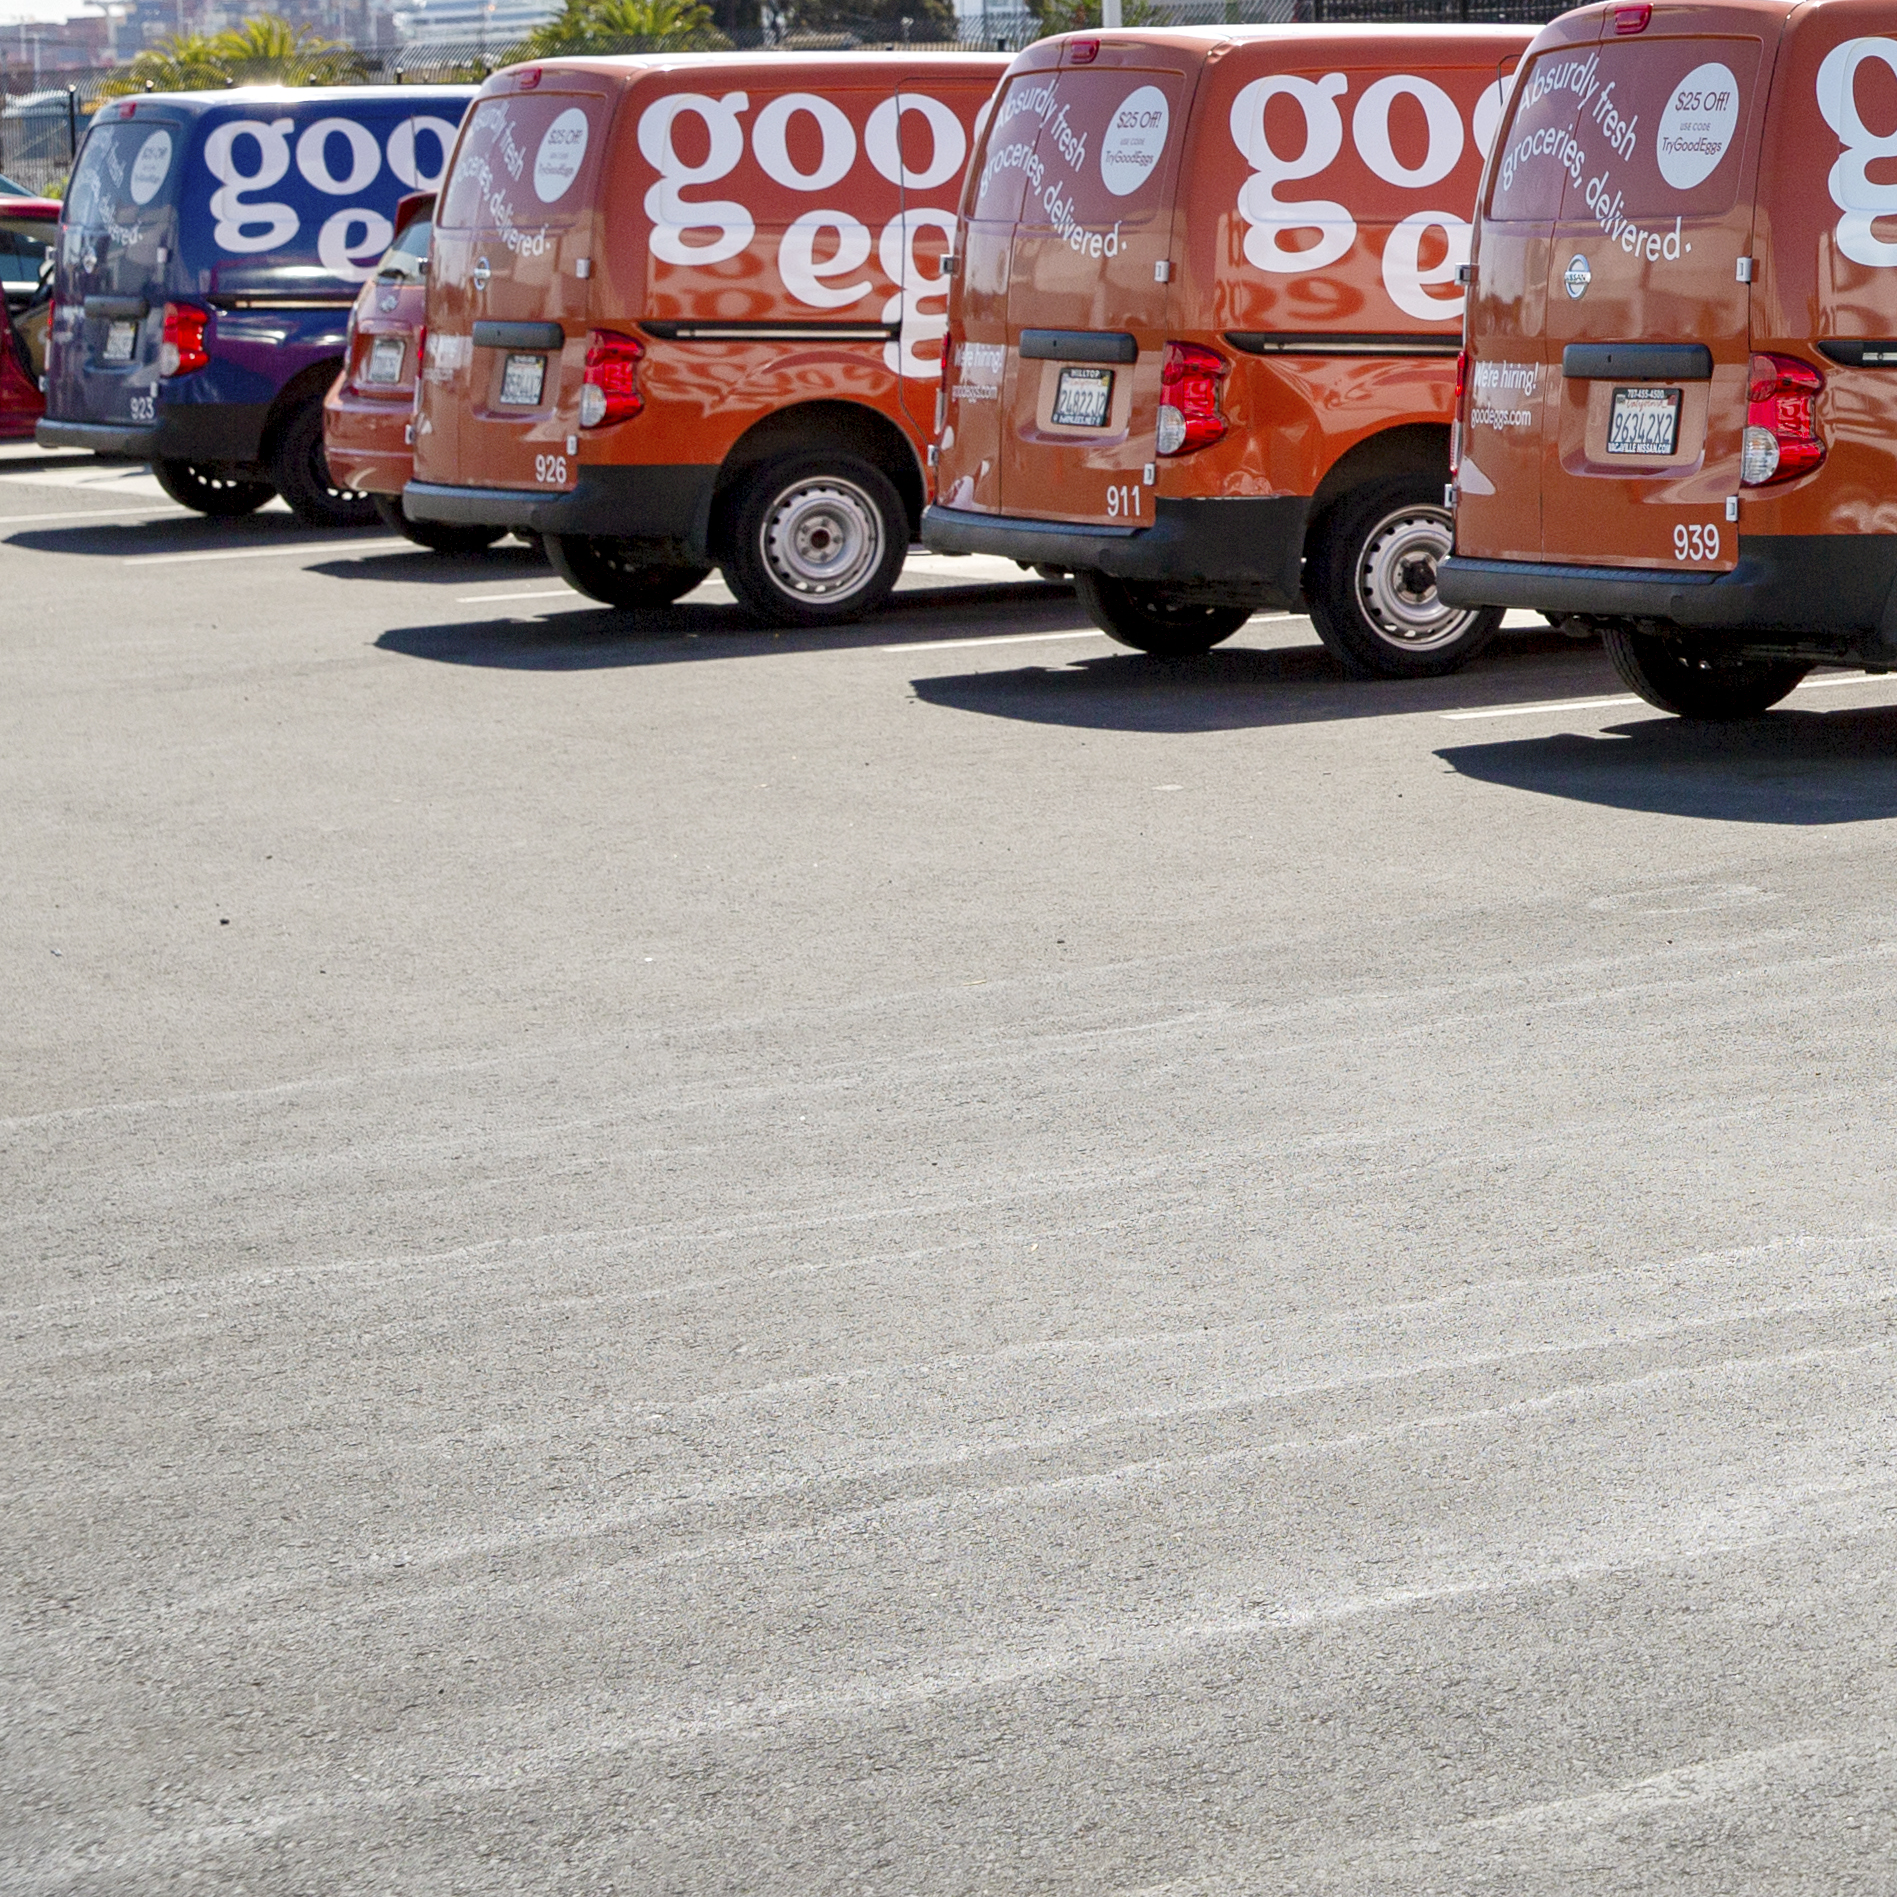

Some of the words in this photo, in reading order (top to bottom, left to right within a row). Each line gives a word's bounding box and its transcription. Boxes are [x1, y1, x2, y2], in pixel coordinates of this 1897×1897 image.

[1516, 53, 1599, 124] Absurdly
[1593, 82, 1638, 161] fresh
[1675, 91, 1701, 112] $25
[1703, 92, 1730, 111] Off!
[1051, 104, 1087, 172] fresh
[1662, 137, 1722, 155] TryGoodEggs
[204, 116, 458, 253] goo
[638, 91, 994, 266] goo
[1503, 124, 1585, 191] groceries,
[1586, 171, 1691, 261] delivered.
[1044, 180, 1127, 258] delivered.
[130, 397, 154, 420] 923
[1471, 407, 1531, 430] goodeggs.com
[1613, 412, 1672, 443] 96342X2
[535, 455, 567, 484] 926
[1107, 485, 1140, 516] 911
[1674, 523, 1720, 561] 939
